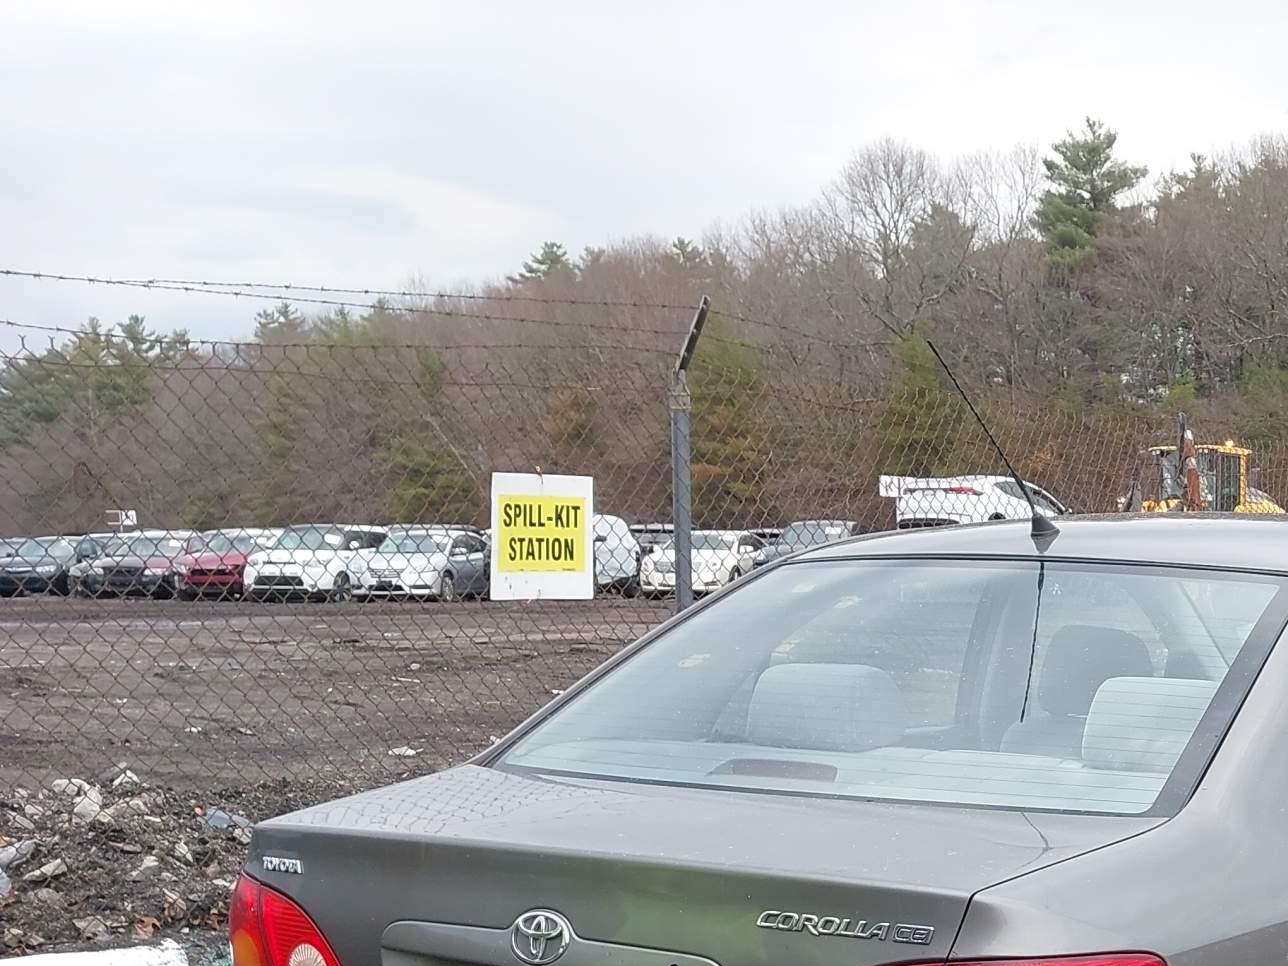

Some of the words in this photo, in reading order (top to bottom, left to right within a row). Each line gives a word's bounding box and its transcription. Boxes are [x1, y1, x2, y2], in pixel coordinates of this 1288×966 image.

[503, 503, 580, 528] SPILL-KIT
[509, 537, 574, 561] STATION
[756, 910, 890, 940] COROLLA
